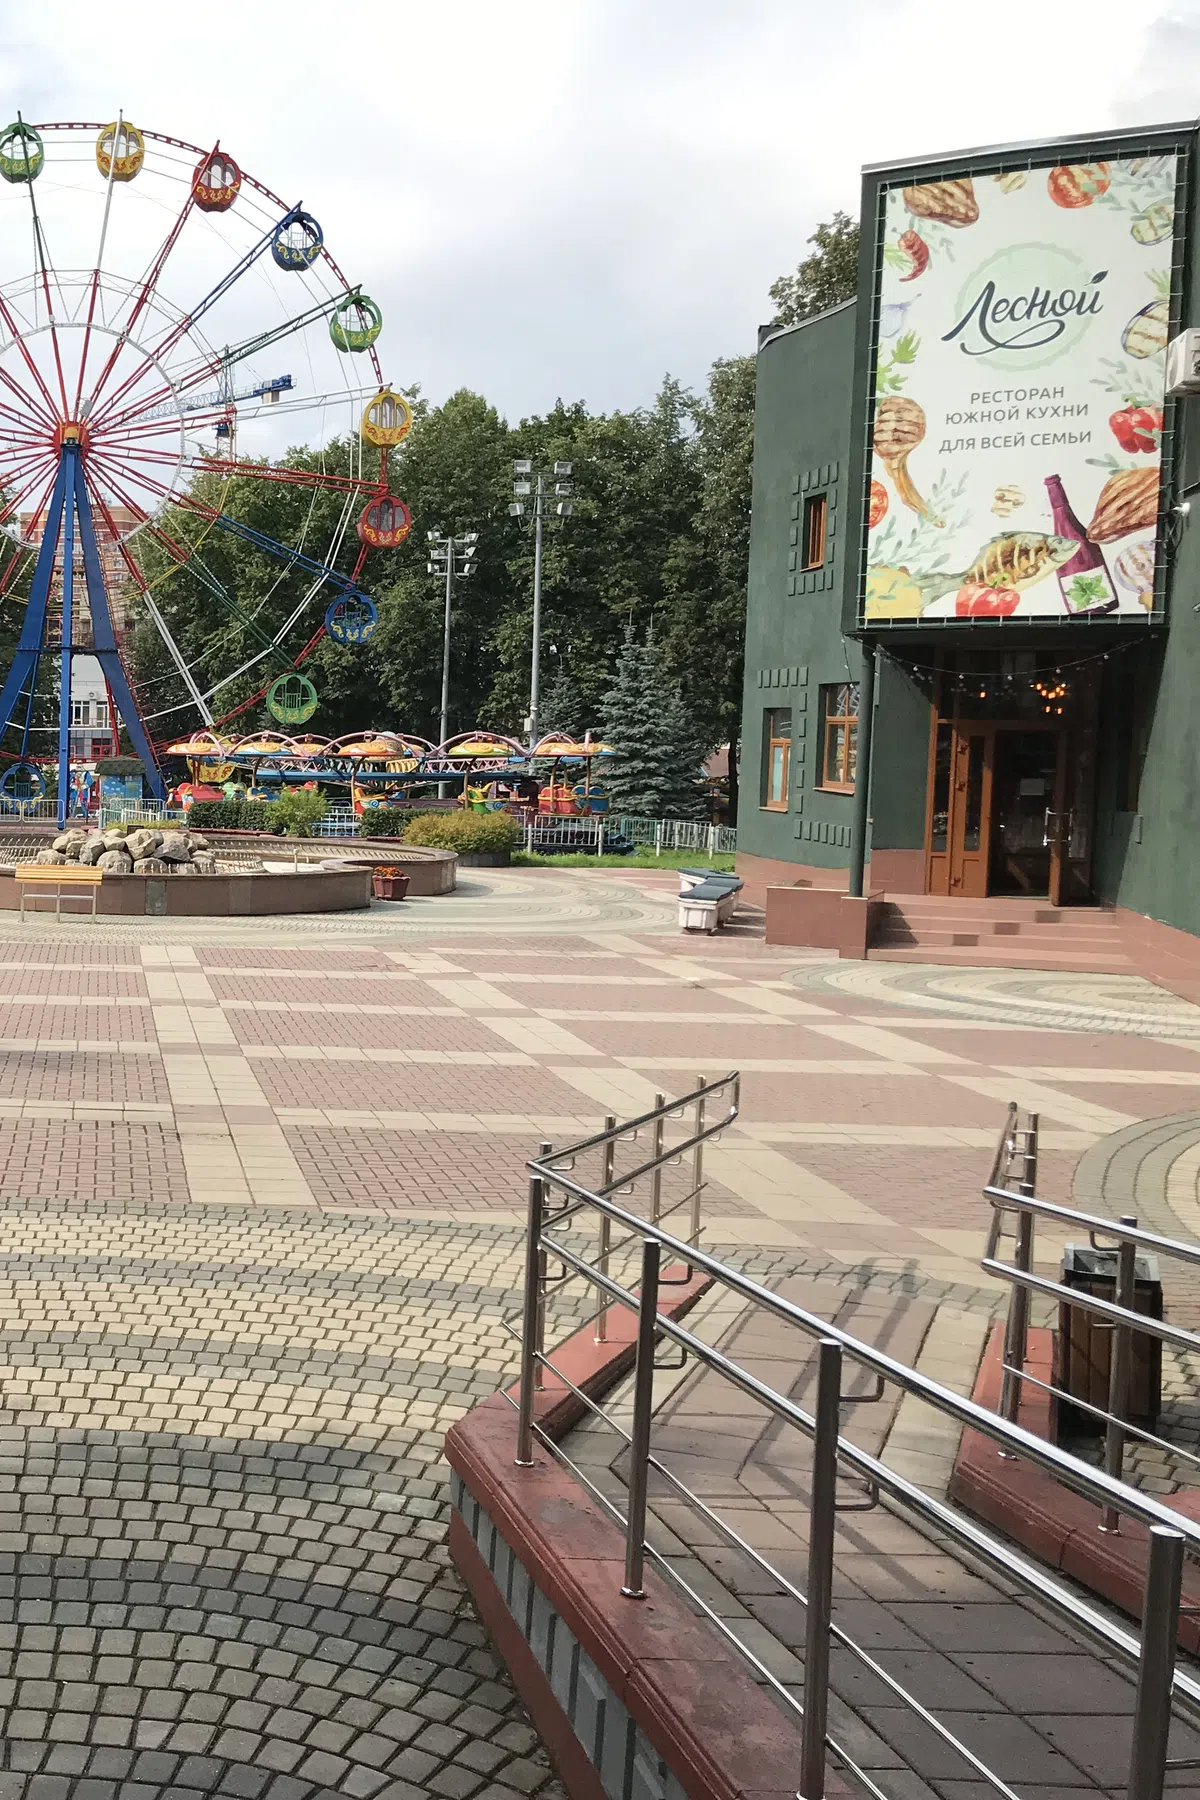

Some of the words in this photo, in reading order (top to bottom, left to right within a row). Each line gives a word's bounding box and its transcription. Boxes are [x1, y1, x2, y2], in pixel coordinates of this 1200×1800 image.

[941, 270, 1109, 355] Лесной
[970, 386, 1065, 404] РЕСТОРАН
[945, 405, 1020, 425] ЮЖНОЙ
[1026, 404, 1089, 420] КУХНИ
[938, 438, 976, 454] ДЛЯ
[981, 432, 1025, 449] ВСЕЙ
[1030, 431, 1092, 446] СЕМЬИ
